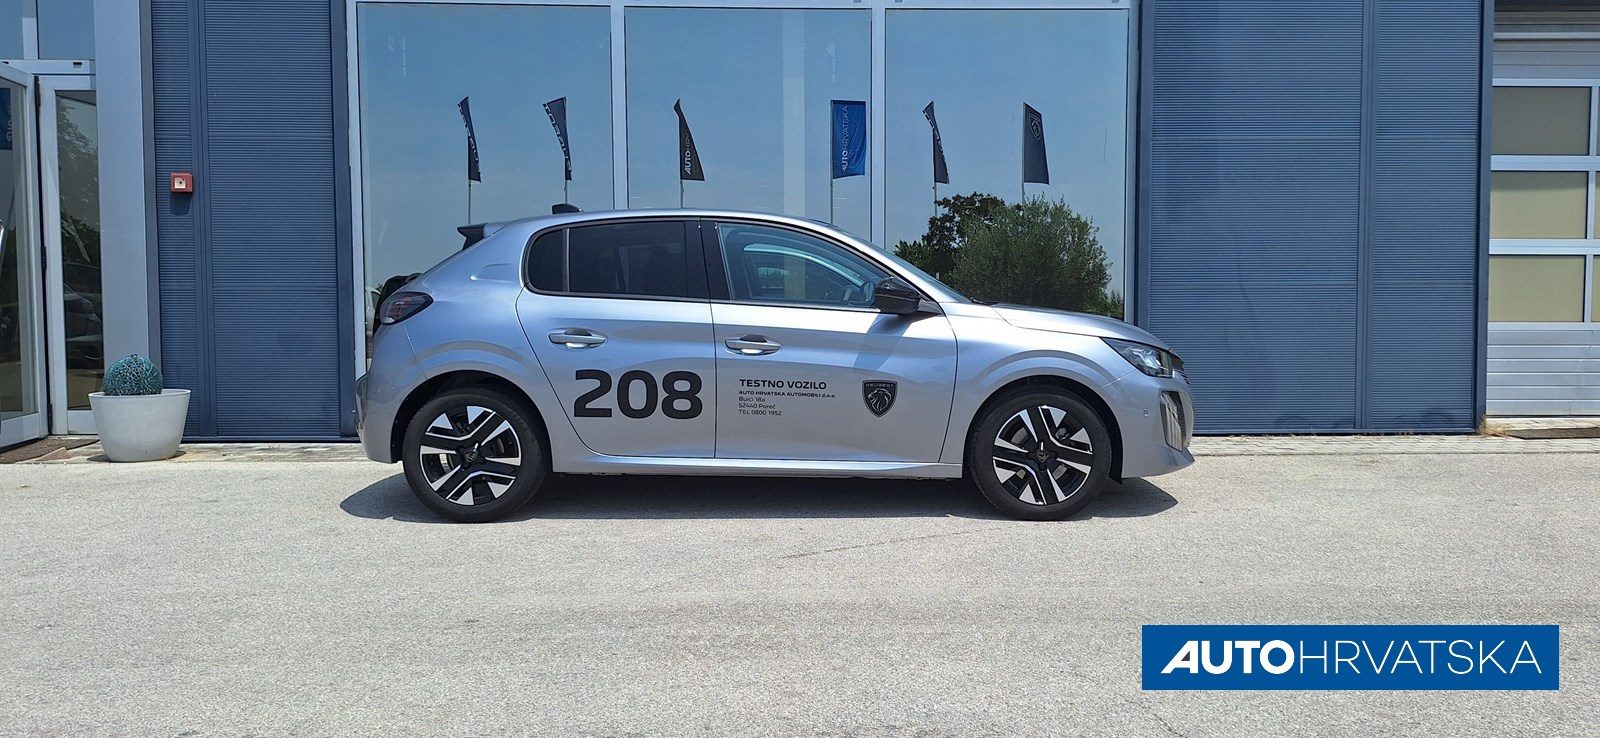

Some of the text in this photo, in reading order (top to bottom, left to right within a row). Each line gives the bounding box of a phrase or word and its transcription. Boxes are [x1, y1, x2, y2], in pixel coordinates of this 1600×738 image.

[841, 105, 850, 172] AUTOHRVATSKA
[573, 369, 703, 420] 208
[739, 379, 827, 390] TESTNO VOZILO
